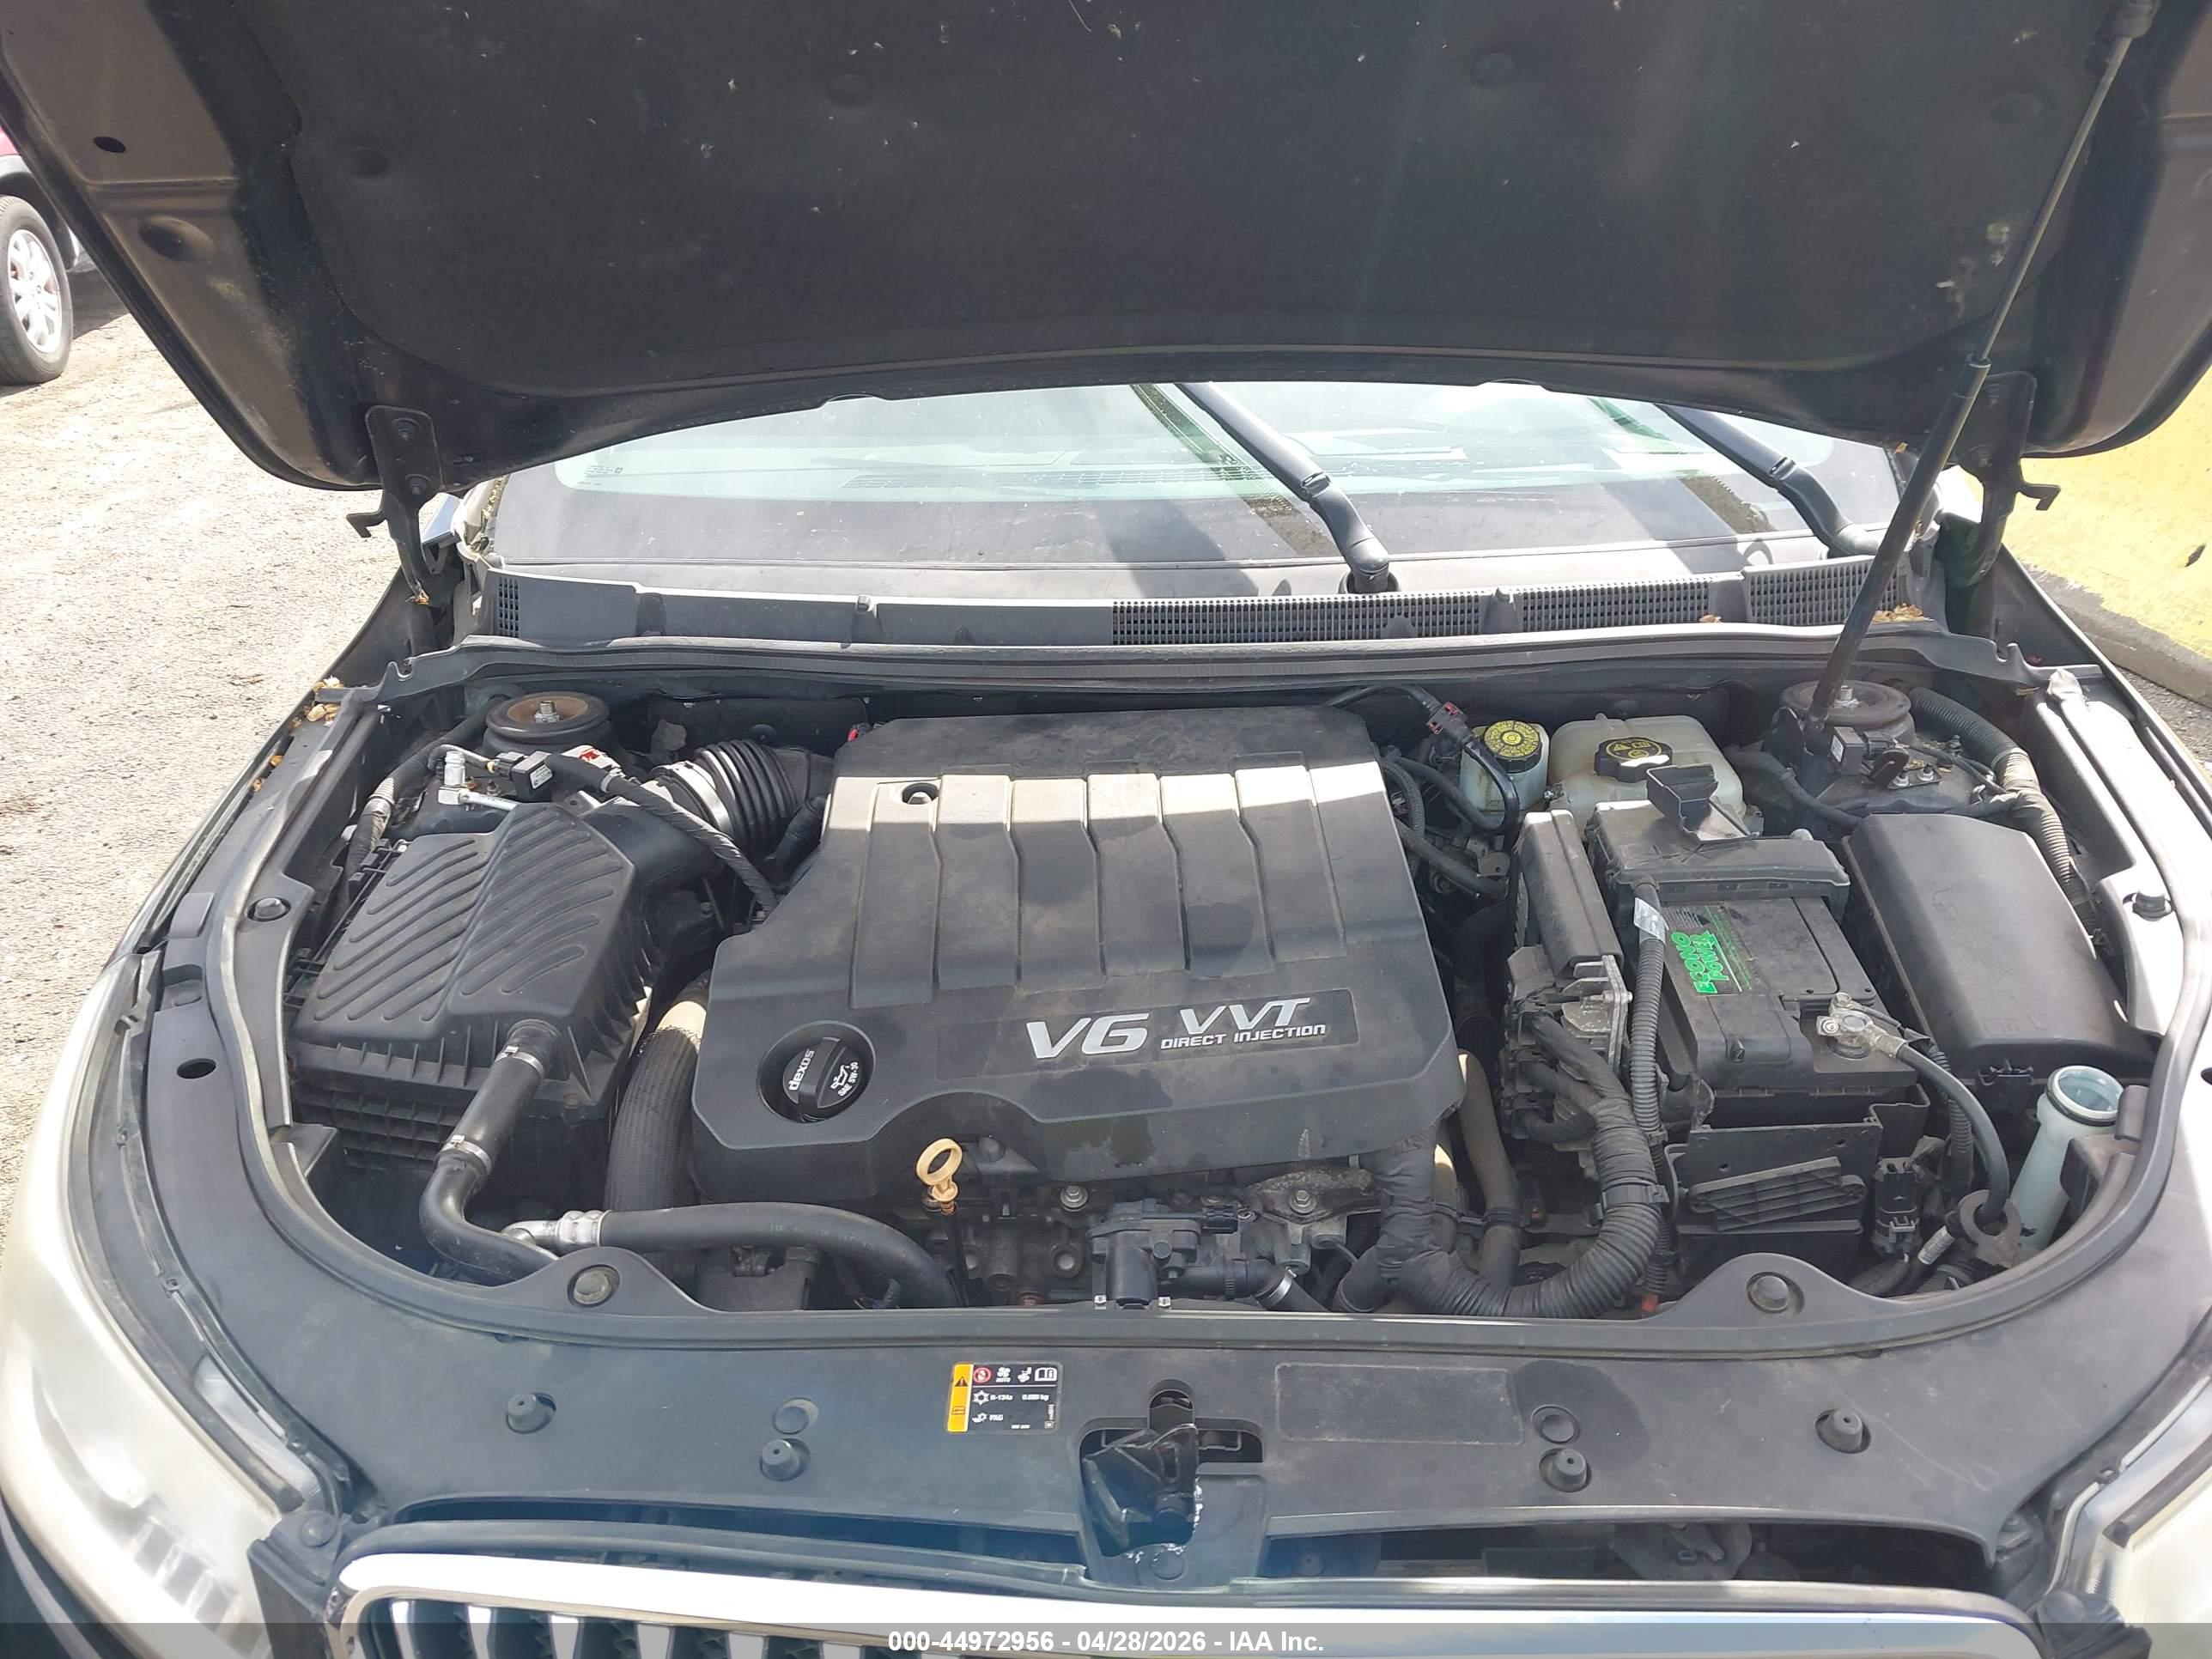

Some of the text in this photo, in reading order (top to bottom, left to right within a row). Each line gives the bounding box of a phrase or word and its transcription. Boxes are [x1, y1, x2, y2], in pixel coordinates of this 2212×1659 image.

[1670, 932, 1718, 994] ECONO
[1689, 930, 1730, 981] POWER
[1026, 998, 1311, 1059] V6 VVT
[1160, 1024, 1327, 1049] DIRECT INJECTION
[788, 1048, 815, 1091] dexos
[837, 1061, 859, 1097] SAE 5W-30
